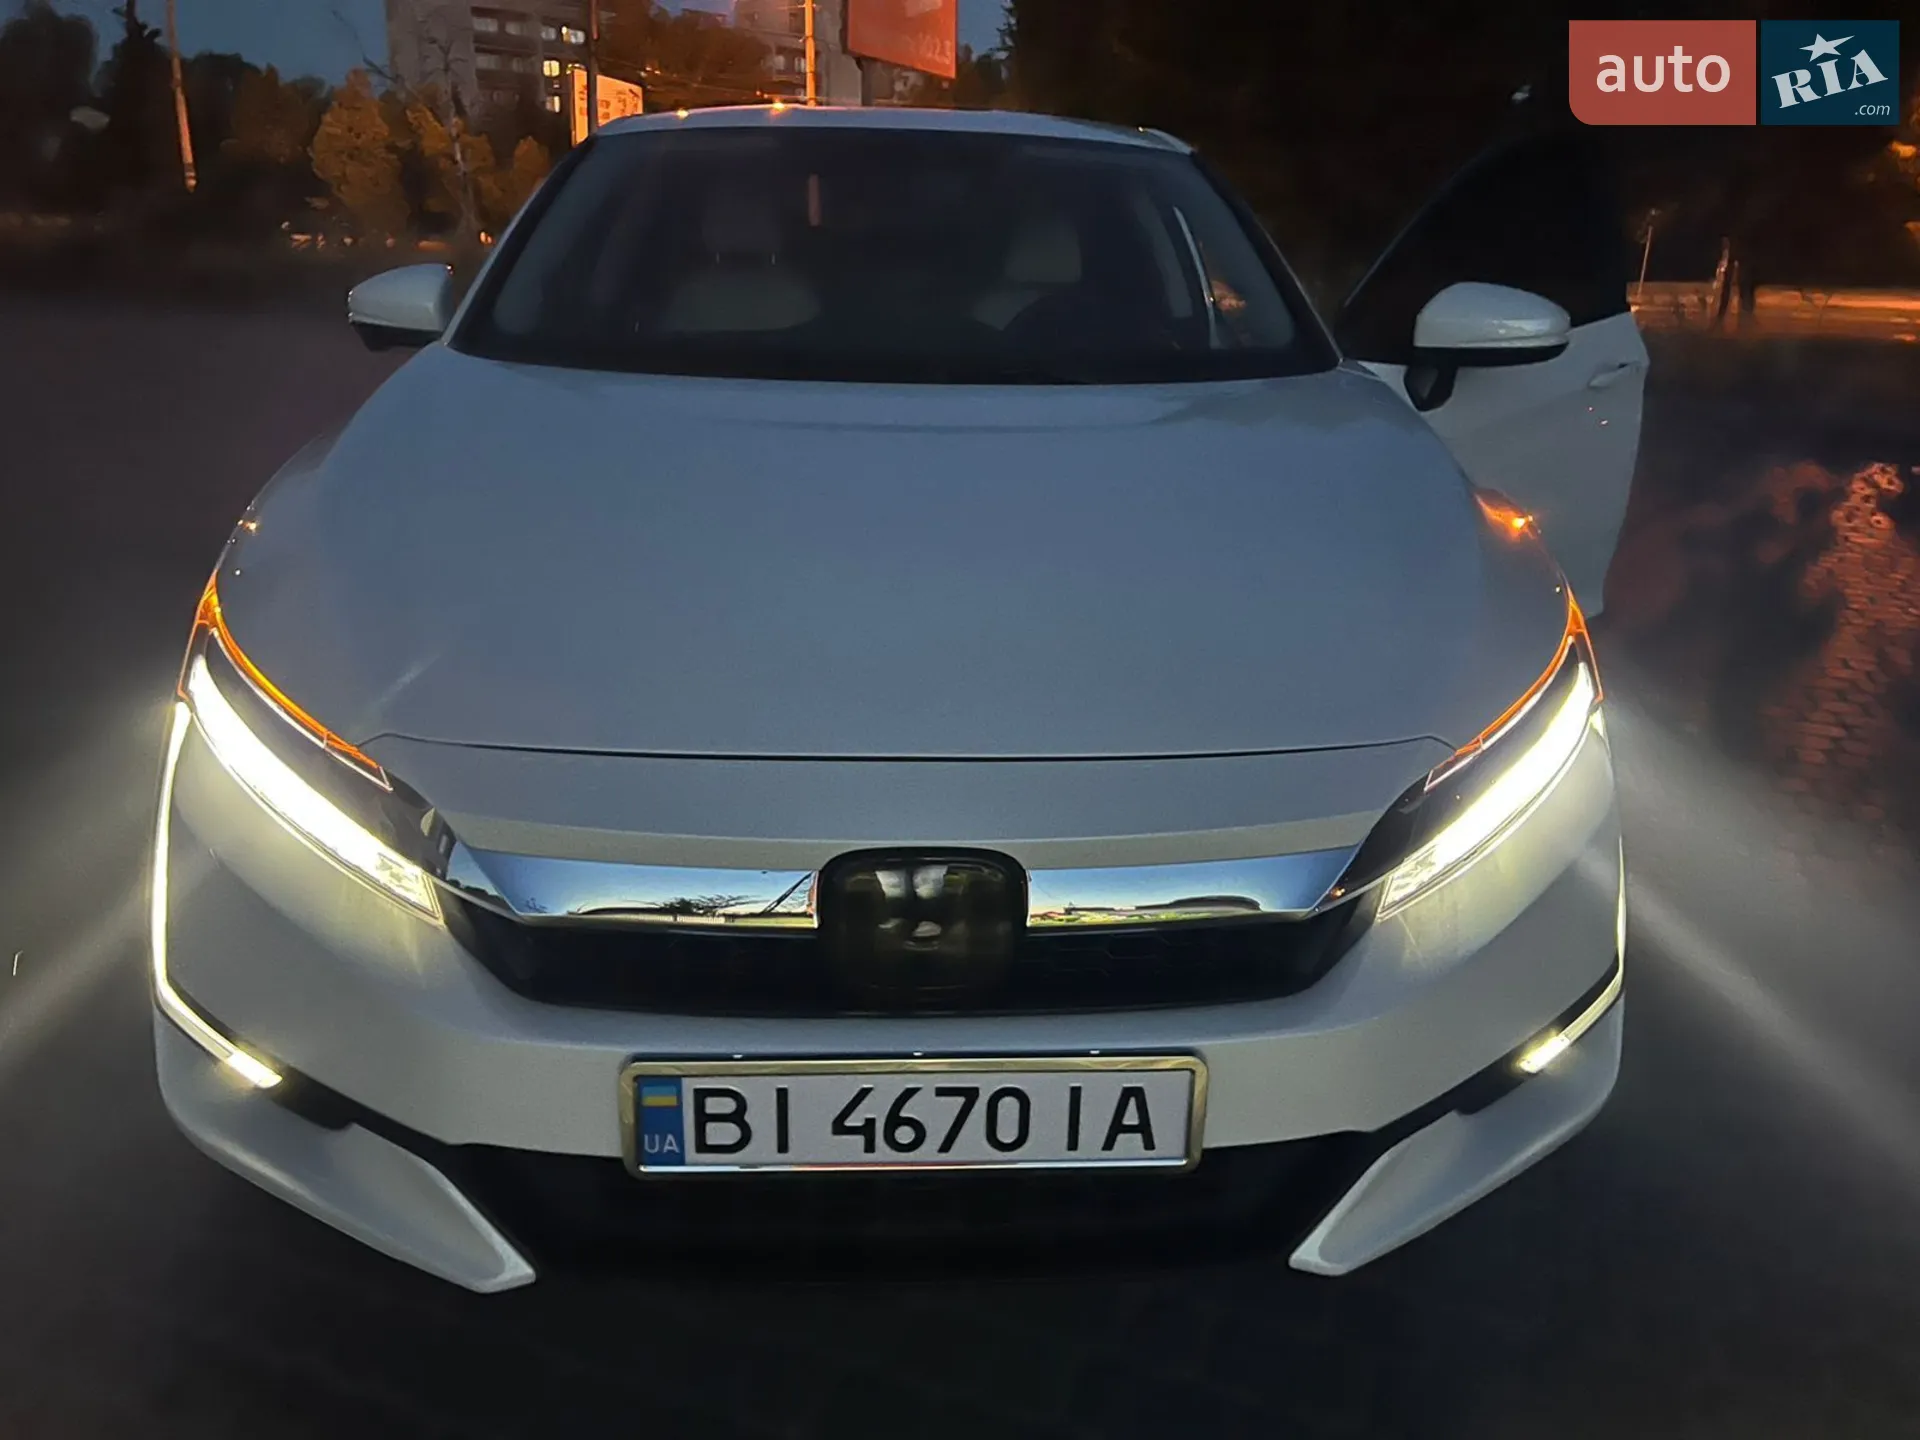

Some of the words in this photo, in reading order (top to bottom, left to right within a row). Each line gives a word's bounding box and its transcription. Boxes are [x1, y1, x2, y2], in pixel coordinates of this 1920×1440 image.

[692, 1086, 790, 1155] BI
[831, 1086, 1032, 1154] 4670
[1066, 1085, 1157, 1152] IA
[643, 1132, 681, 1155] UA
